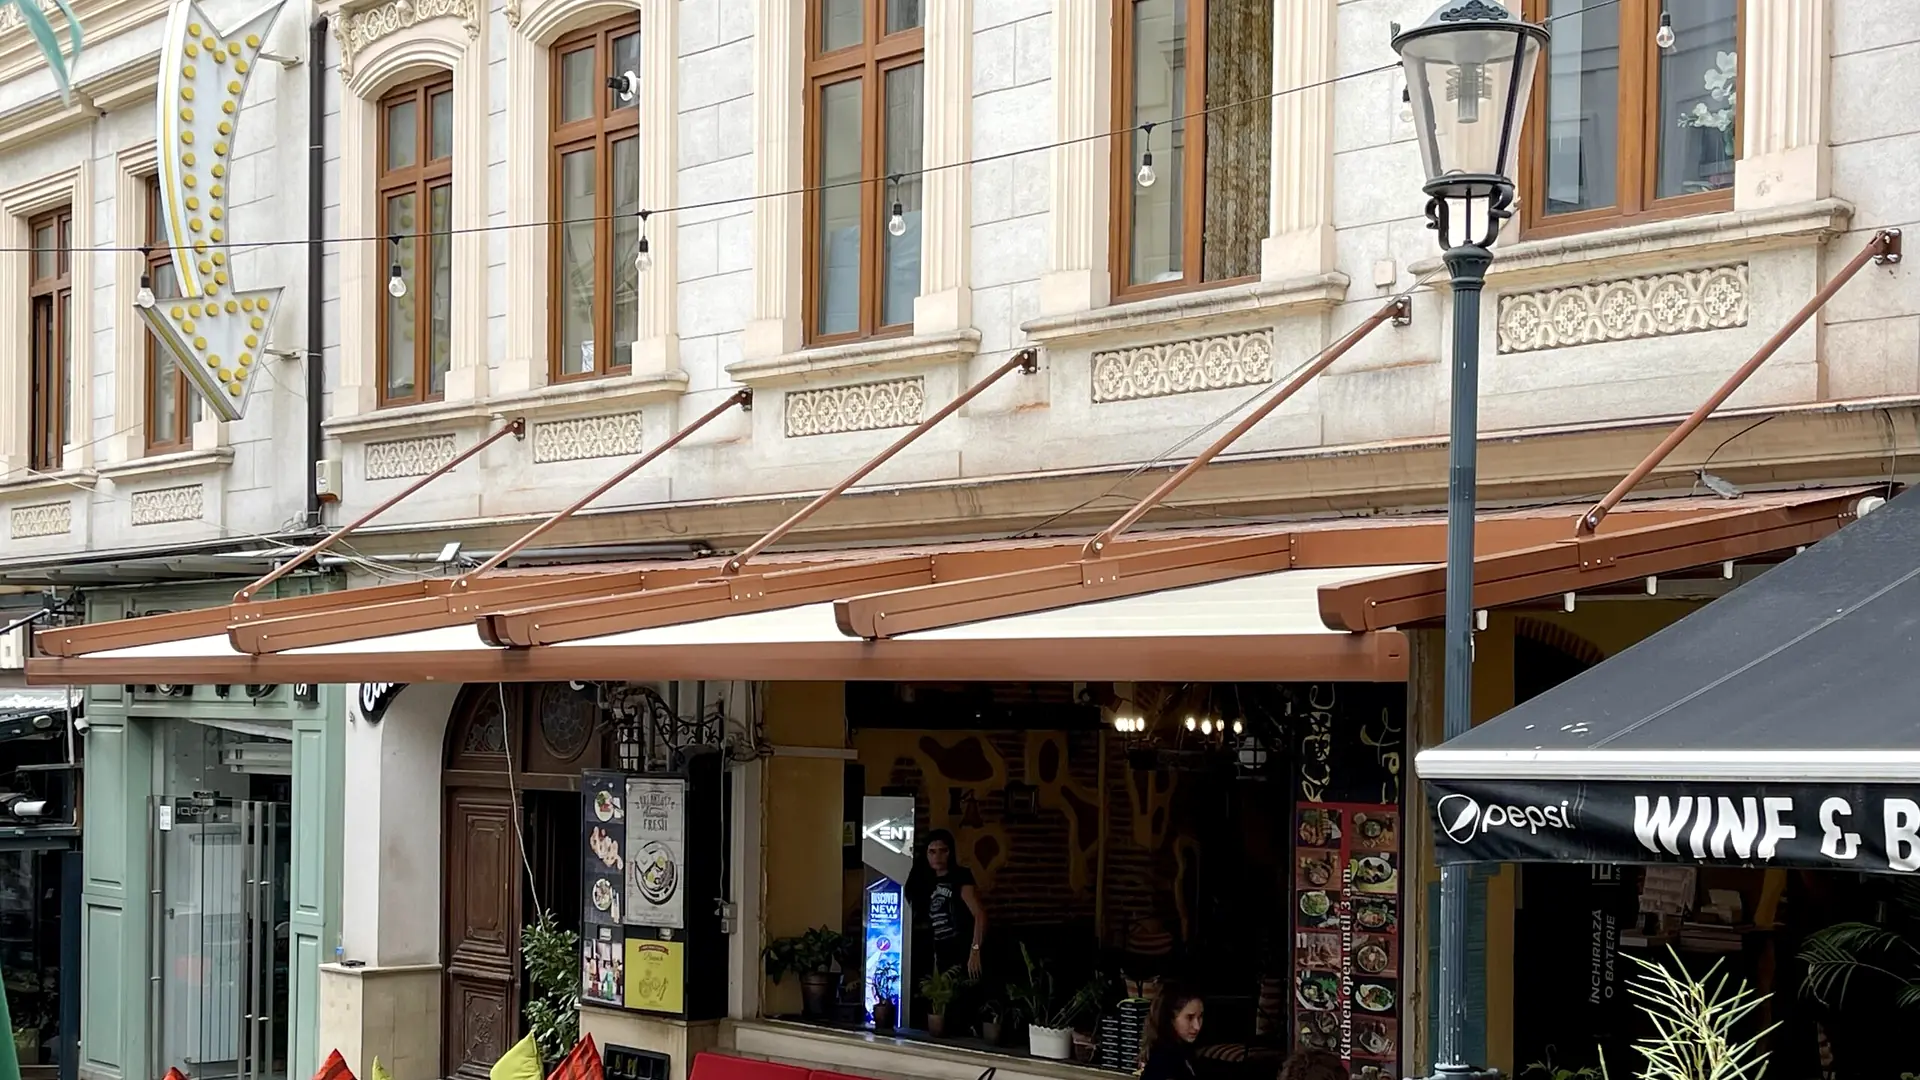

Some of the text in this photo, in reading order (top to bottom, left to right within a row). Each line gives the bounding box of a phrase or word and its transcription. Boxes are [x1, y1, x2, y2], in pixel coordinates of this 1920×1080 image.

[1482, 800, 1571, 834] pepsi
[862, 819, 914, 853] KENT
[871, 904, 898, 914] NEW
[1340, 864, 1354, 1060] Kitchen open until 3 a.m.
[1604, 915, 1615, 998] O BATERIE
